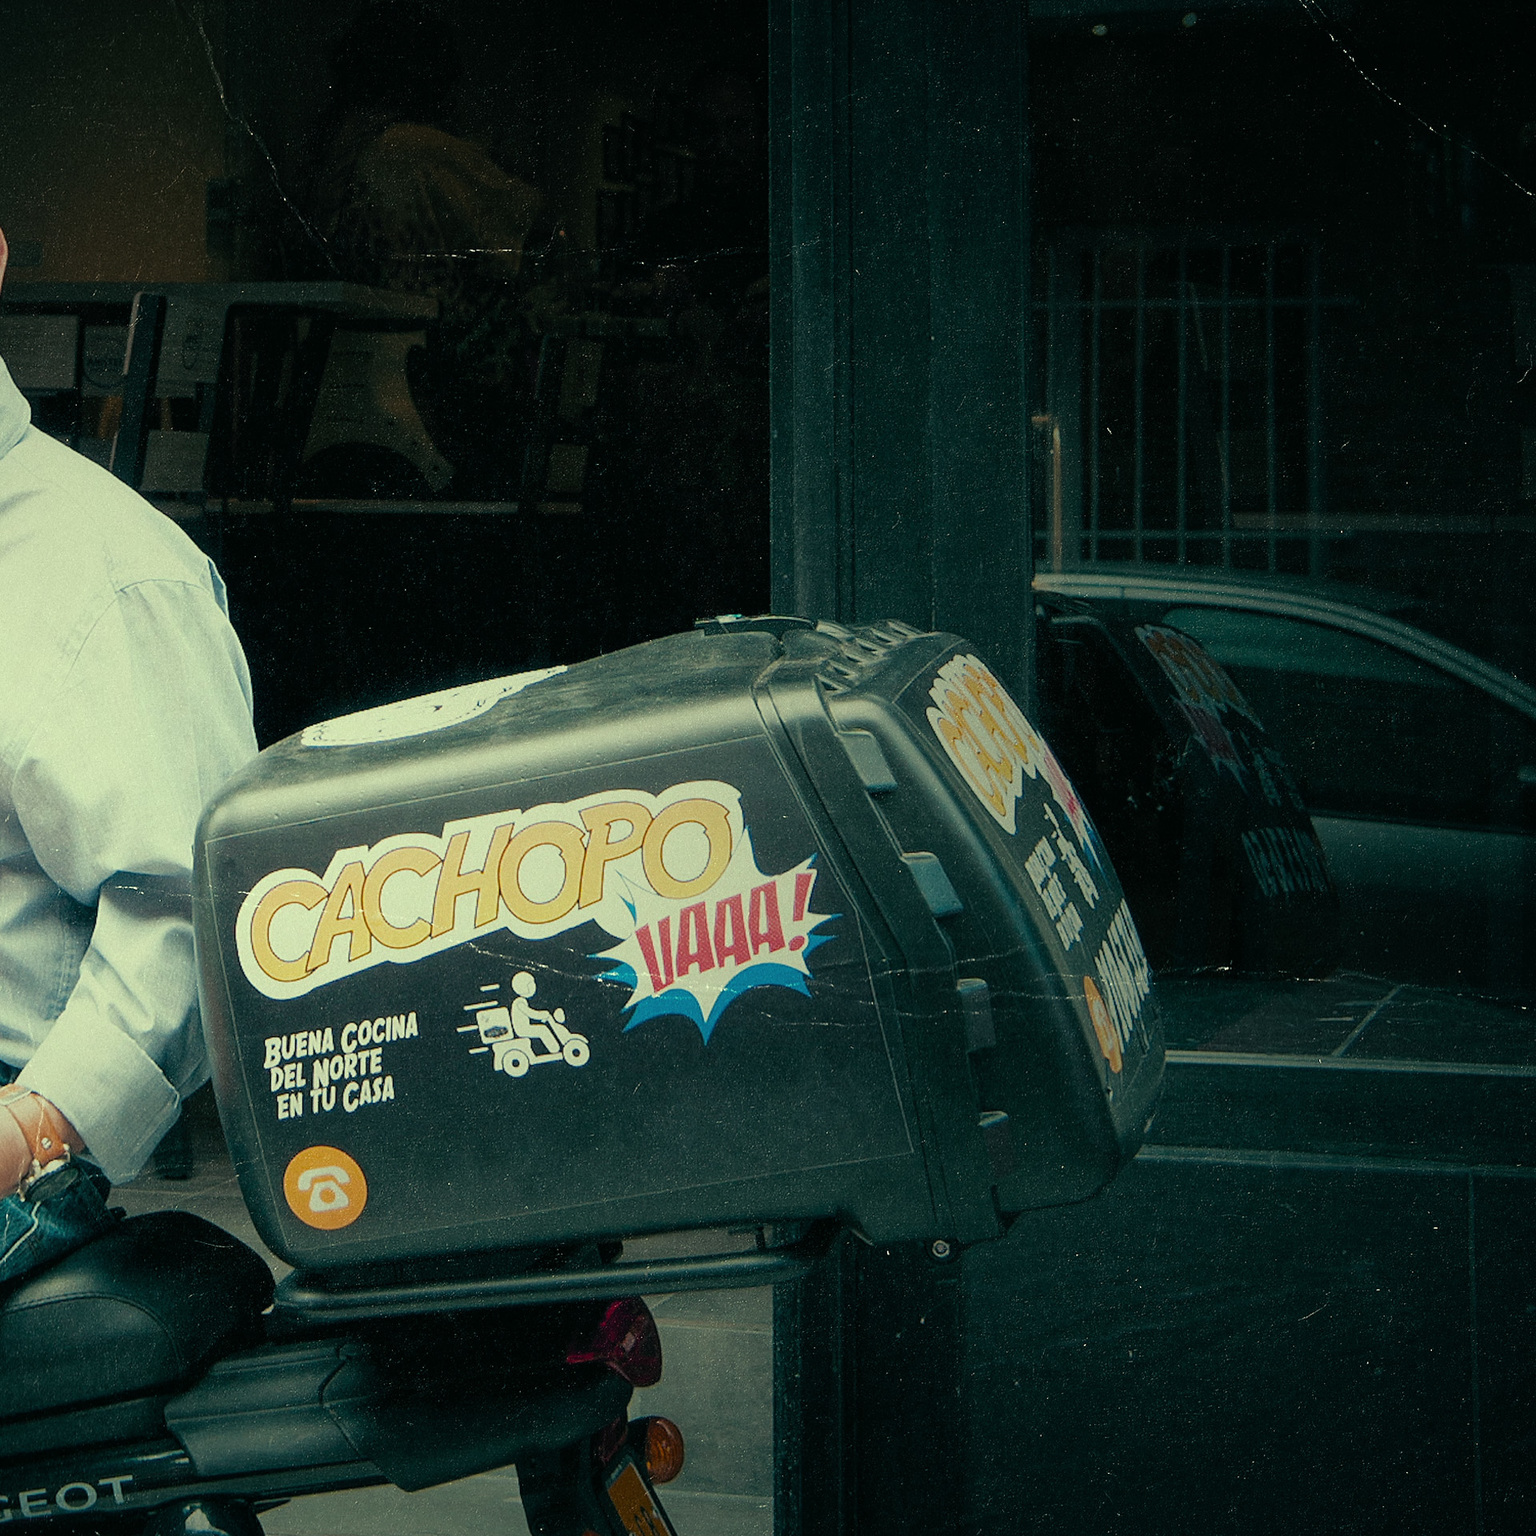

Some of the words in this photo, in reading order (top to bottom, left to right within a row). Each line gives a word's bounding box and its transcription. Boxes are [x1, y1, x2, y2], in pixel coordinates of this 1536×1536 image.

[250, 798, 731, 983] CACHOPO
[635, 873, 812, 993] VAAA!
[263, 1027, 334, 1069] BUENA
[340, 1011, 418, 1053] COCINA
[270, 1062, 306, 1092] DEL
[313, 1047, 382, 1089] NORTE
[276, 1092, 303, 1120] EN
[310, 1085, 336, 1114] TU
[343, 1075, 395, 1113] CASA
